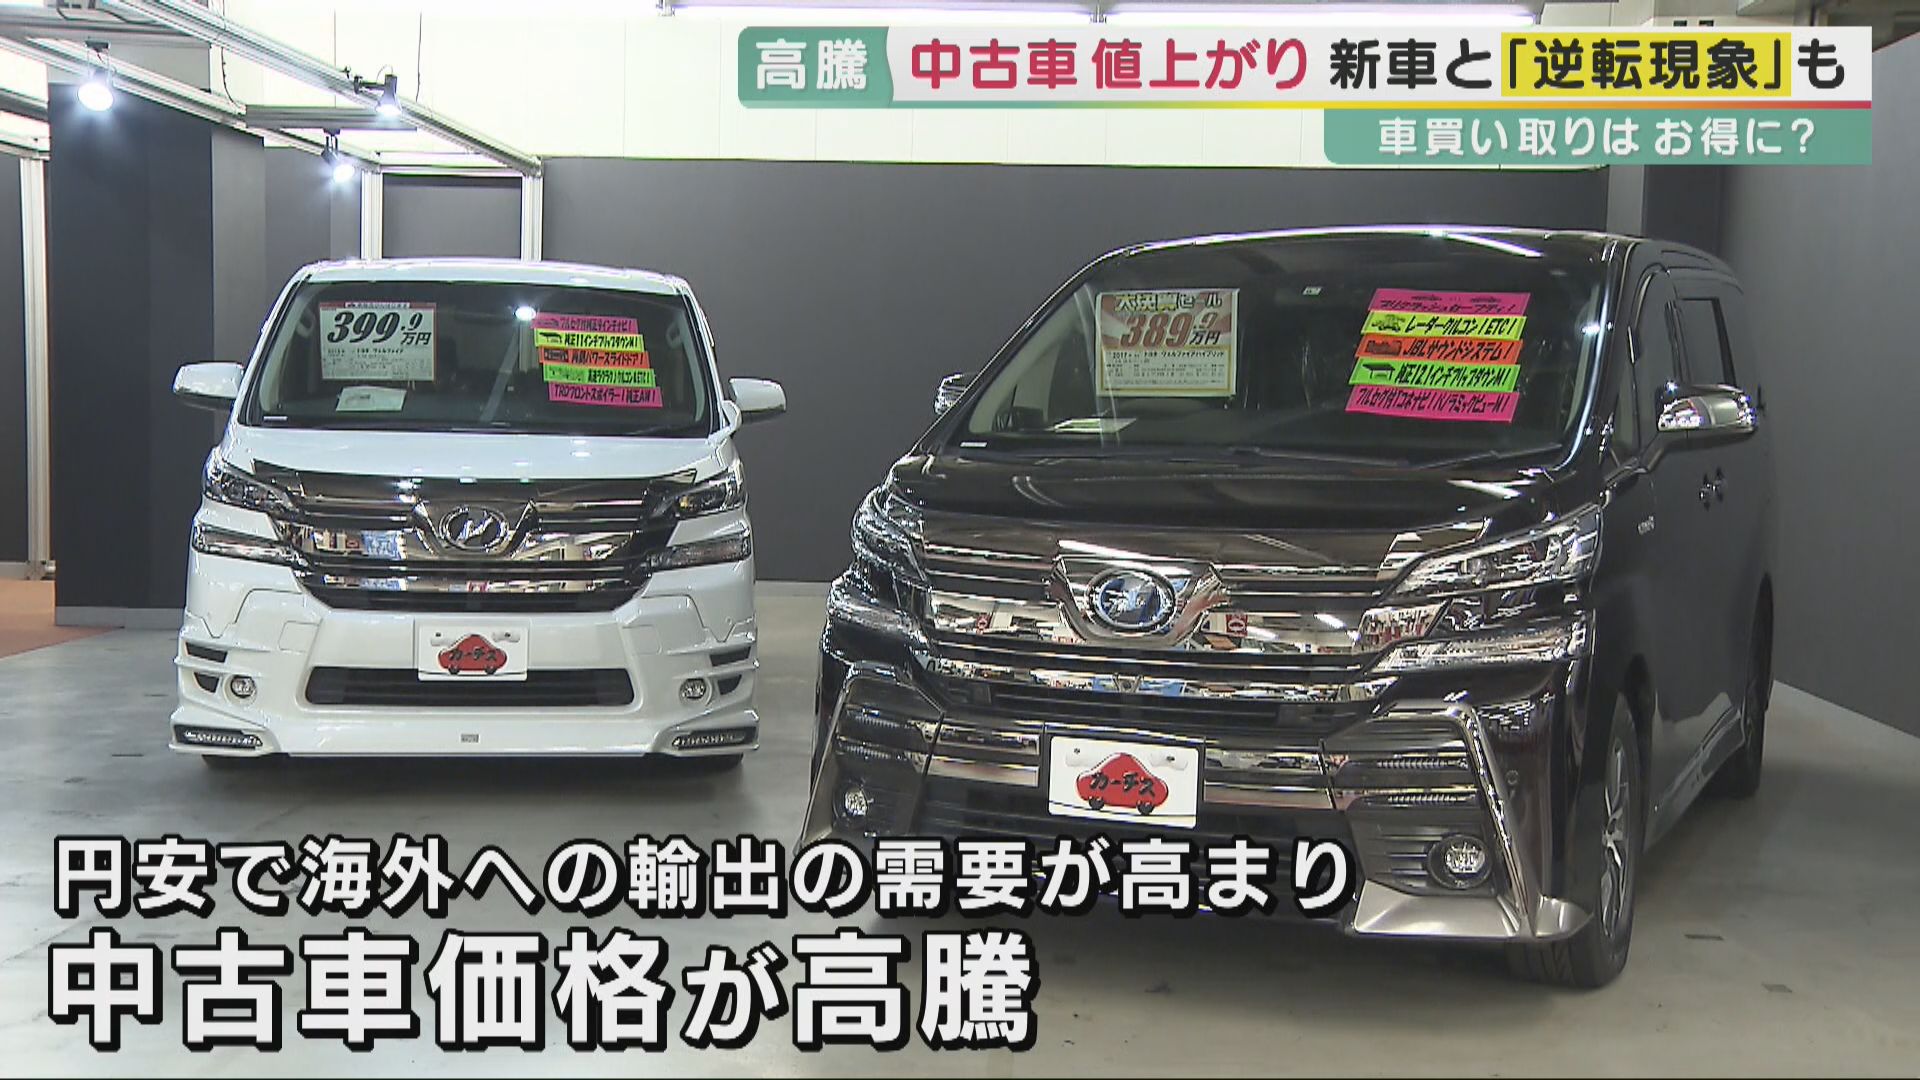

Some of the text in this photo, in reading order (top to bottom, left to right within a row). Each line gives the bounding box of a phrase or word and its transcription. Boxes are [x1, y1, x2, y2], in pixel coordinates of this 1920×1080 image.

[449, 646, 498, 661] カーチス
[1089, 771, 1155, 798] カーチス
